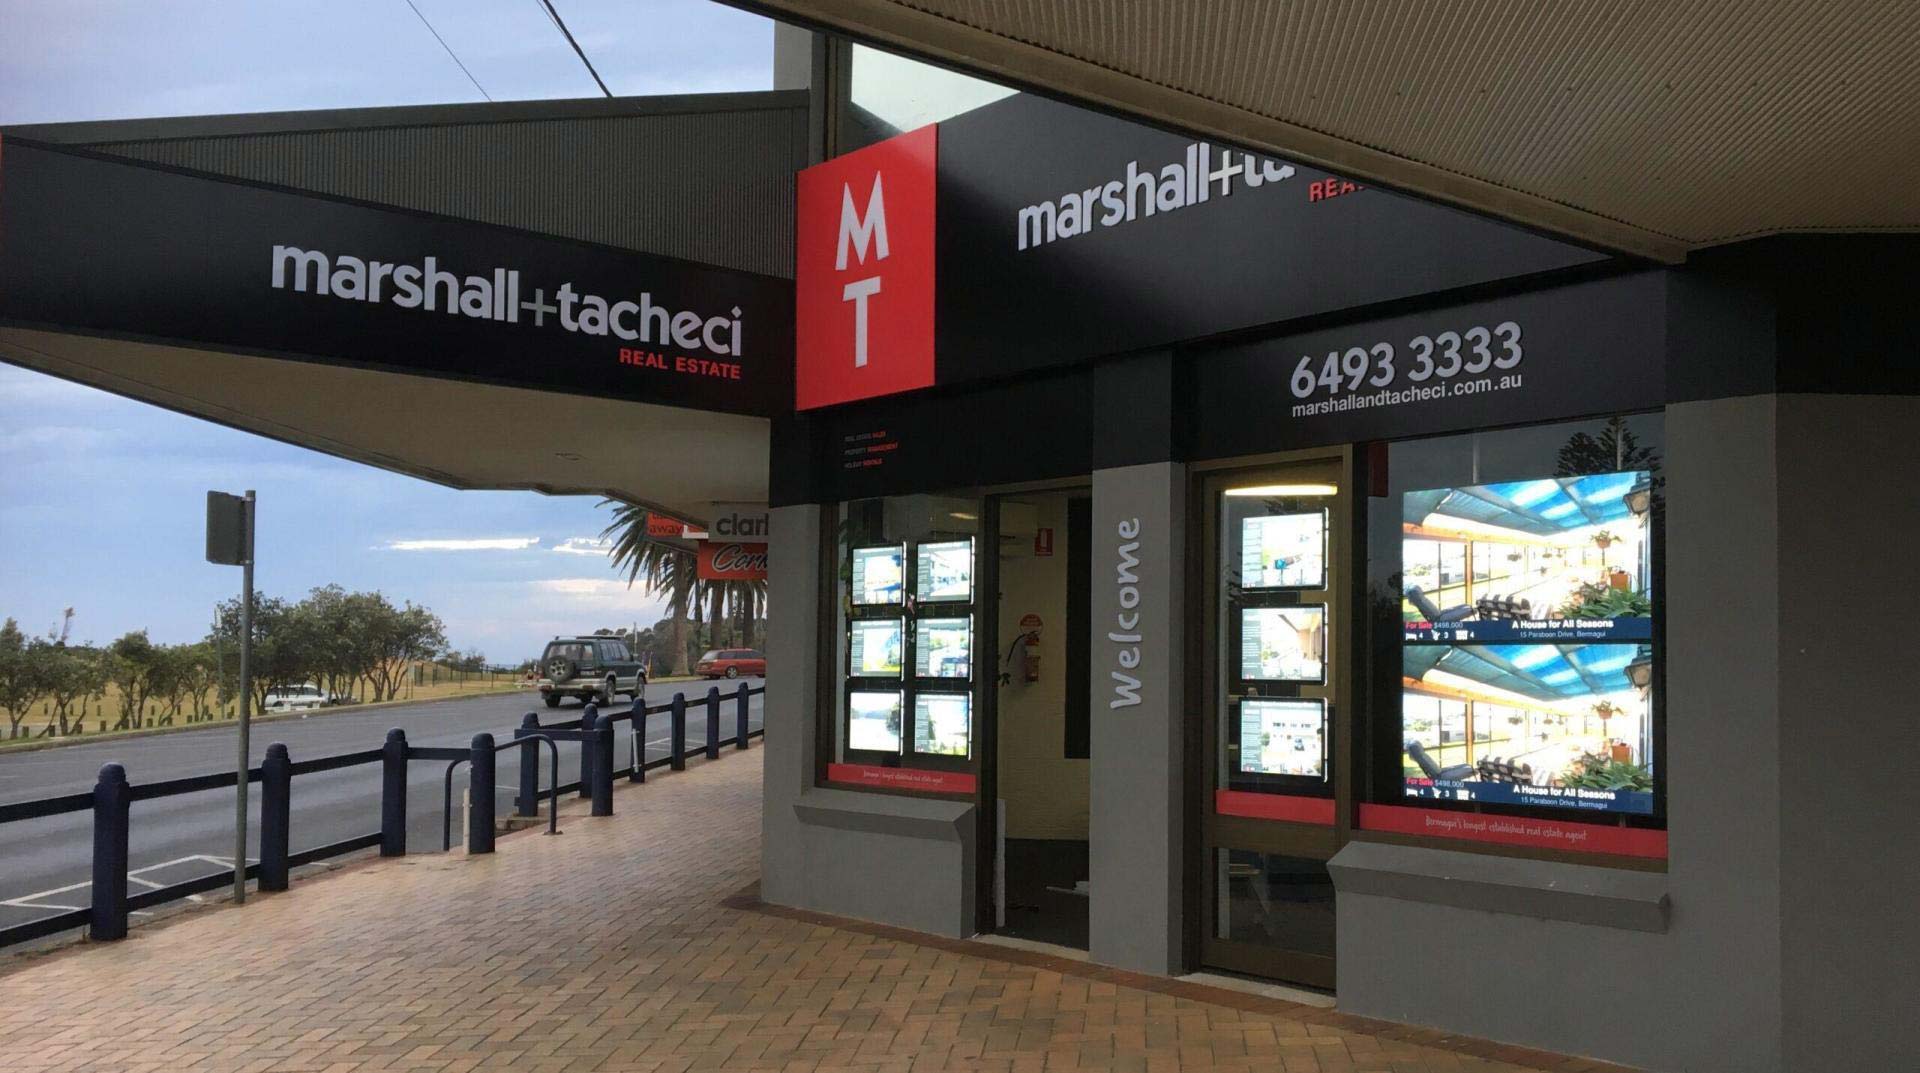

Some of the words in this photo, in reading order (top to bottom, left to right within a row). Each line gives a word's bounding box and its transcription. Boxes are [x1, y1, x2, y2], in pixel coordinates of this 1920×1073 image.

[1309, 176, 1366, 202] REA
[834, 170, 890, 270] M
[271, 244, 742, 357] marshall+tacheci
[842, 276, 882, 368] T
[619, 347, 668, 371] REAL
[676, 355, 742, 381] ESTATE
[1290, 341, 1396, 399] 6493
[1407, 320, 1523, 382] 3333
[1291, 373, 1522, 418] marshallandtacheci.com.au
[1108, 517, 1142, 709] Welcome
[1520, 620, 1548, 629] House
[1548, 619, 1560, 629] for
[1562, 619, 1575, 628] All
[1576, 619, 1614, 629] Seasons
[1521, 785, 1549, 795] House
[1550, 786, 1562, 796] for
[1564, 787, 1576, 797] All
[1577, 788, 1616, 800] Seasons
[1488, 821, 1525, 835] established
[1565, 829, 1588, 843] agent
